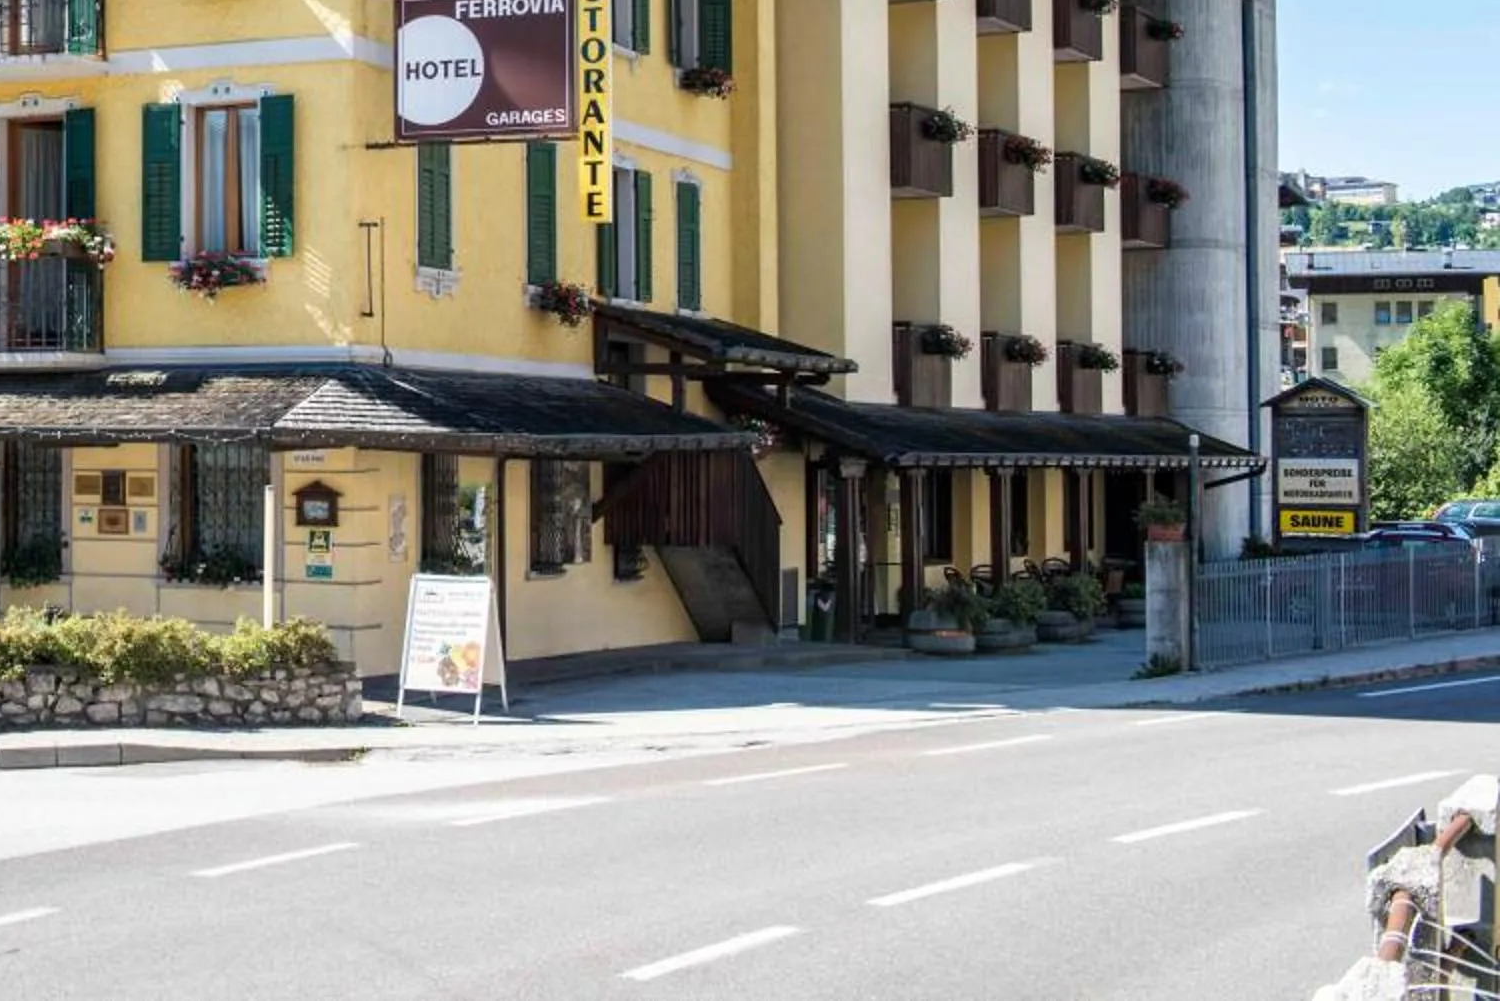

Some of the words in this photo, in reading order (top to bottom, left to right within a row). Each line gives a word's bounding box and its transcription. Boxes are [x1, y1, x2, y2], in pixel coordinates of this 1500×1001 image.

[406, 58, 482, 80] HOTEL
[485, 108, 566, 126] GARAGES
[1290, 514, 1345, 528] SAUNE
